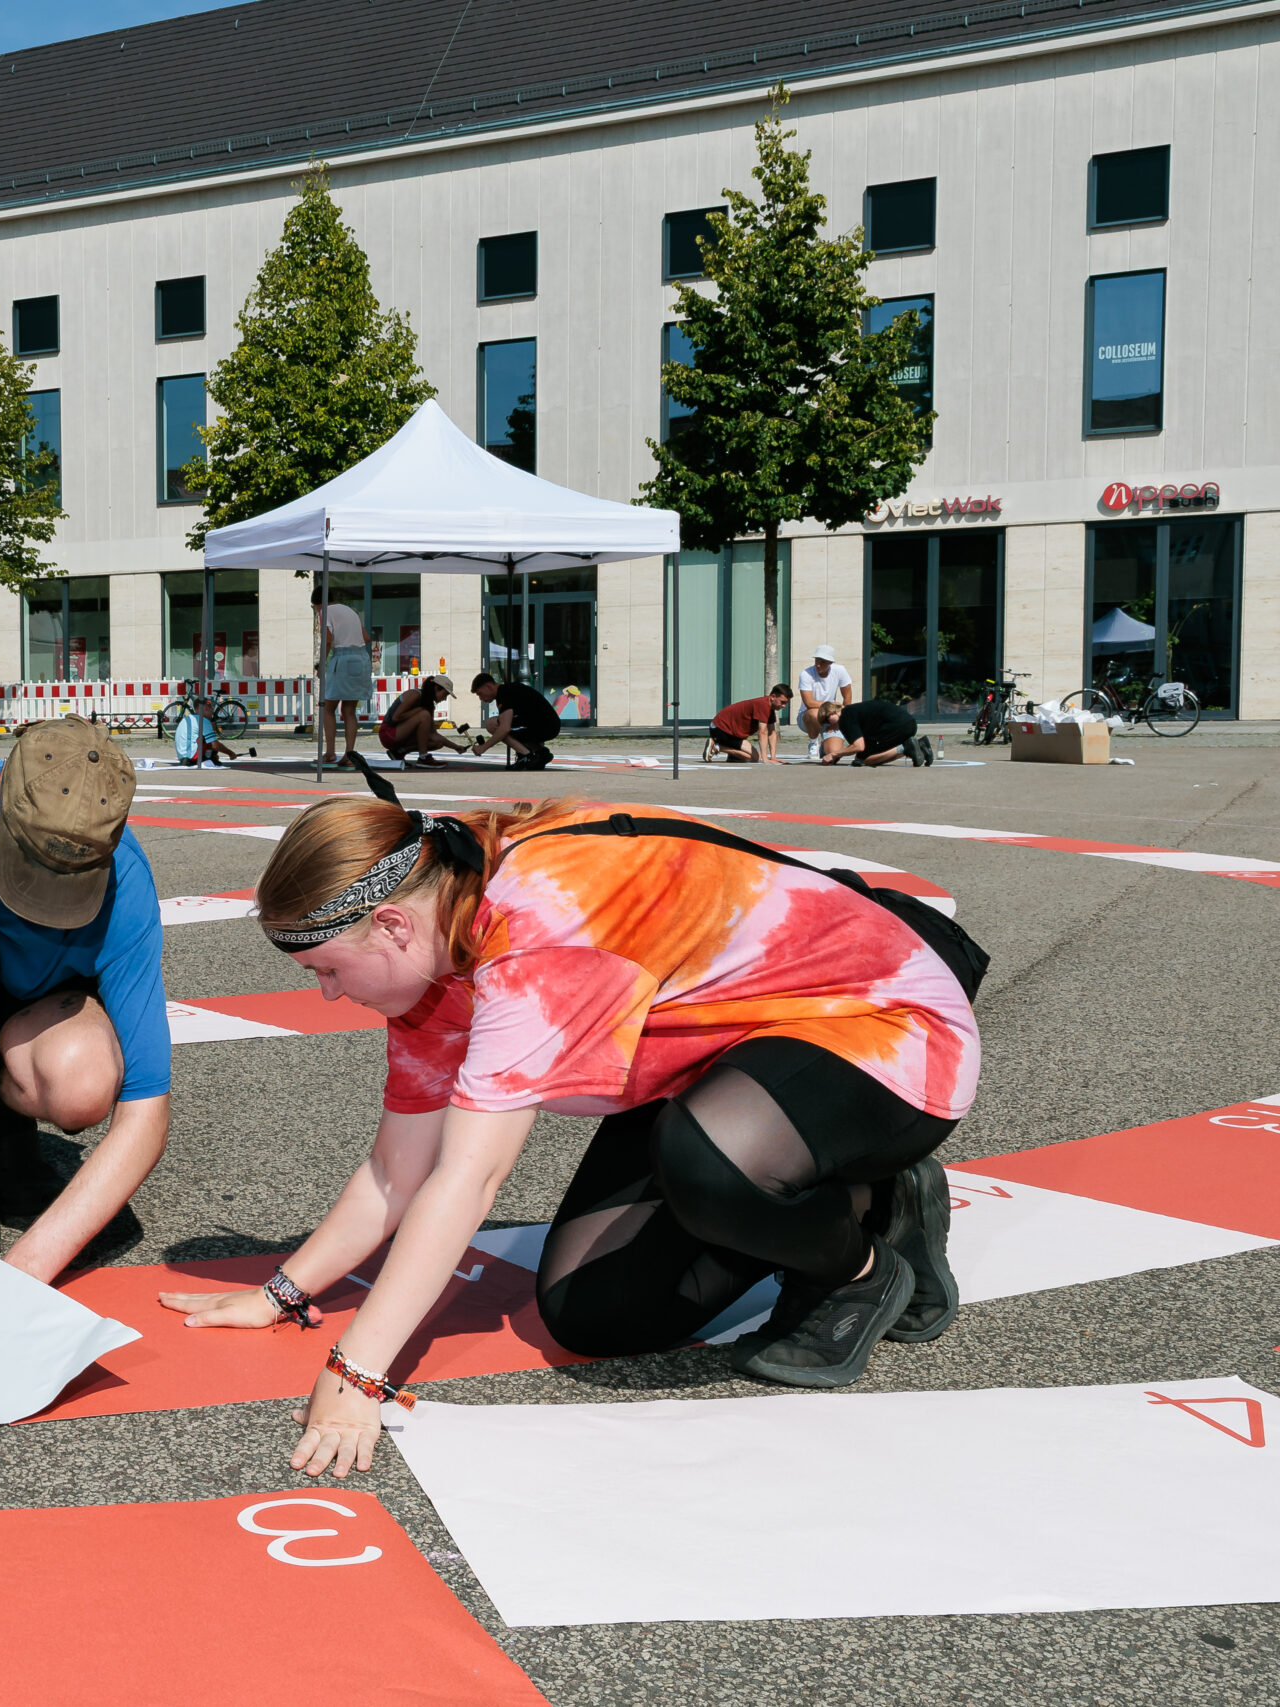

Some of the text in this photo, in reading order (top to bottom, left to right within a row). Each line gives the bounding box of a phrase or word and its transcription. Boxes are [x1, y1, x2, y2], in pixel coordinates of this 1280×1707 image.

[1098, 342, 1156, 360] COLLOSEUM
[1143, 1391, 1266, 1448] 4
[237, 1498, 383, 1567] 3
